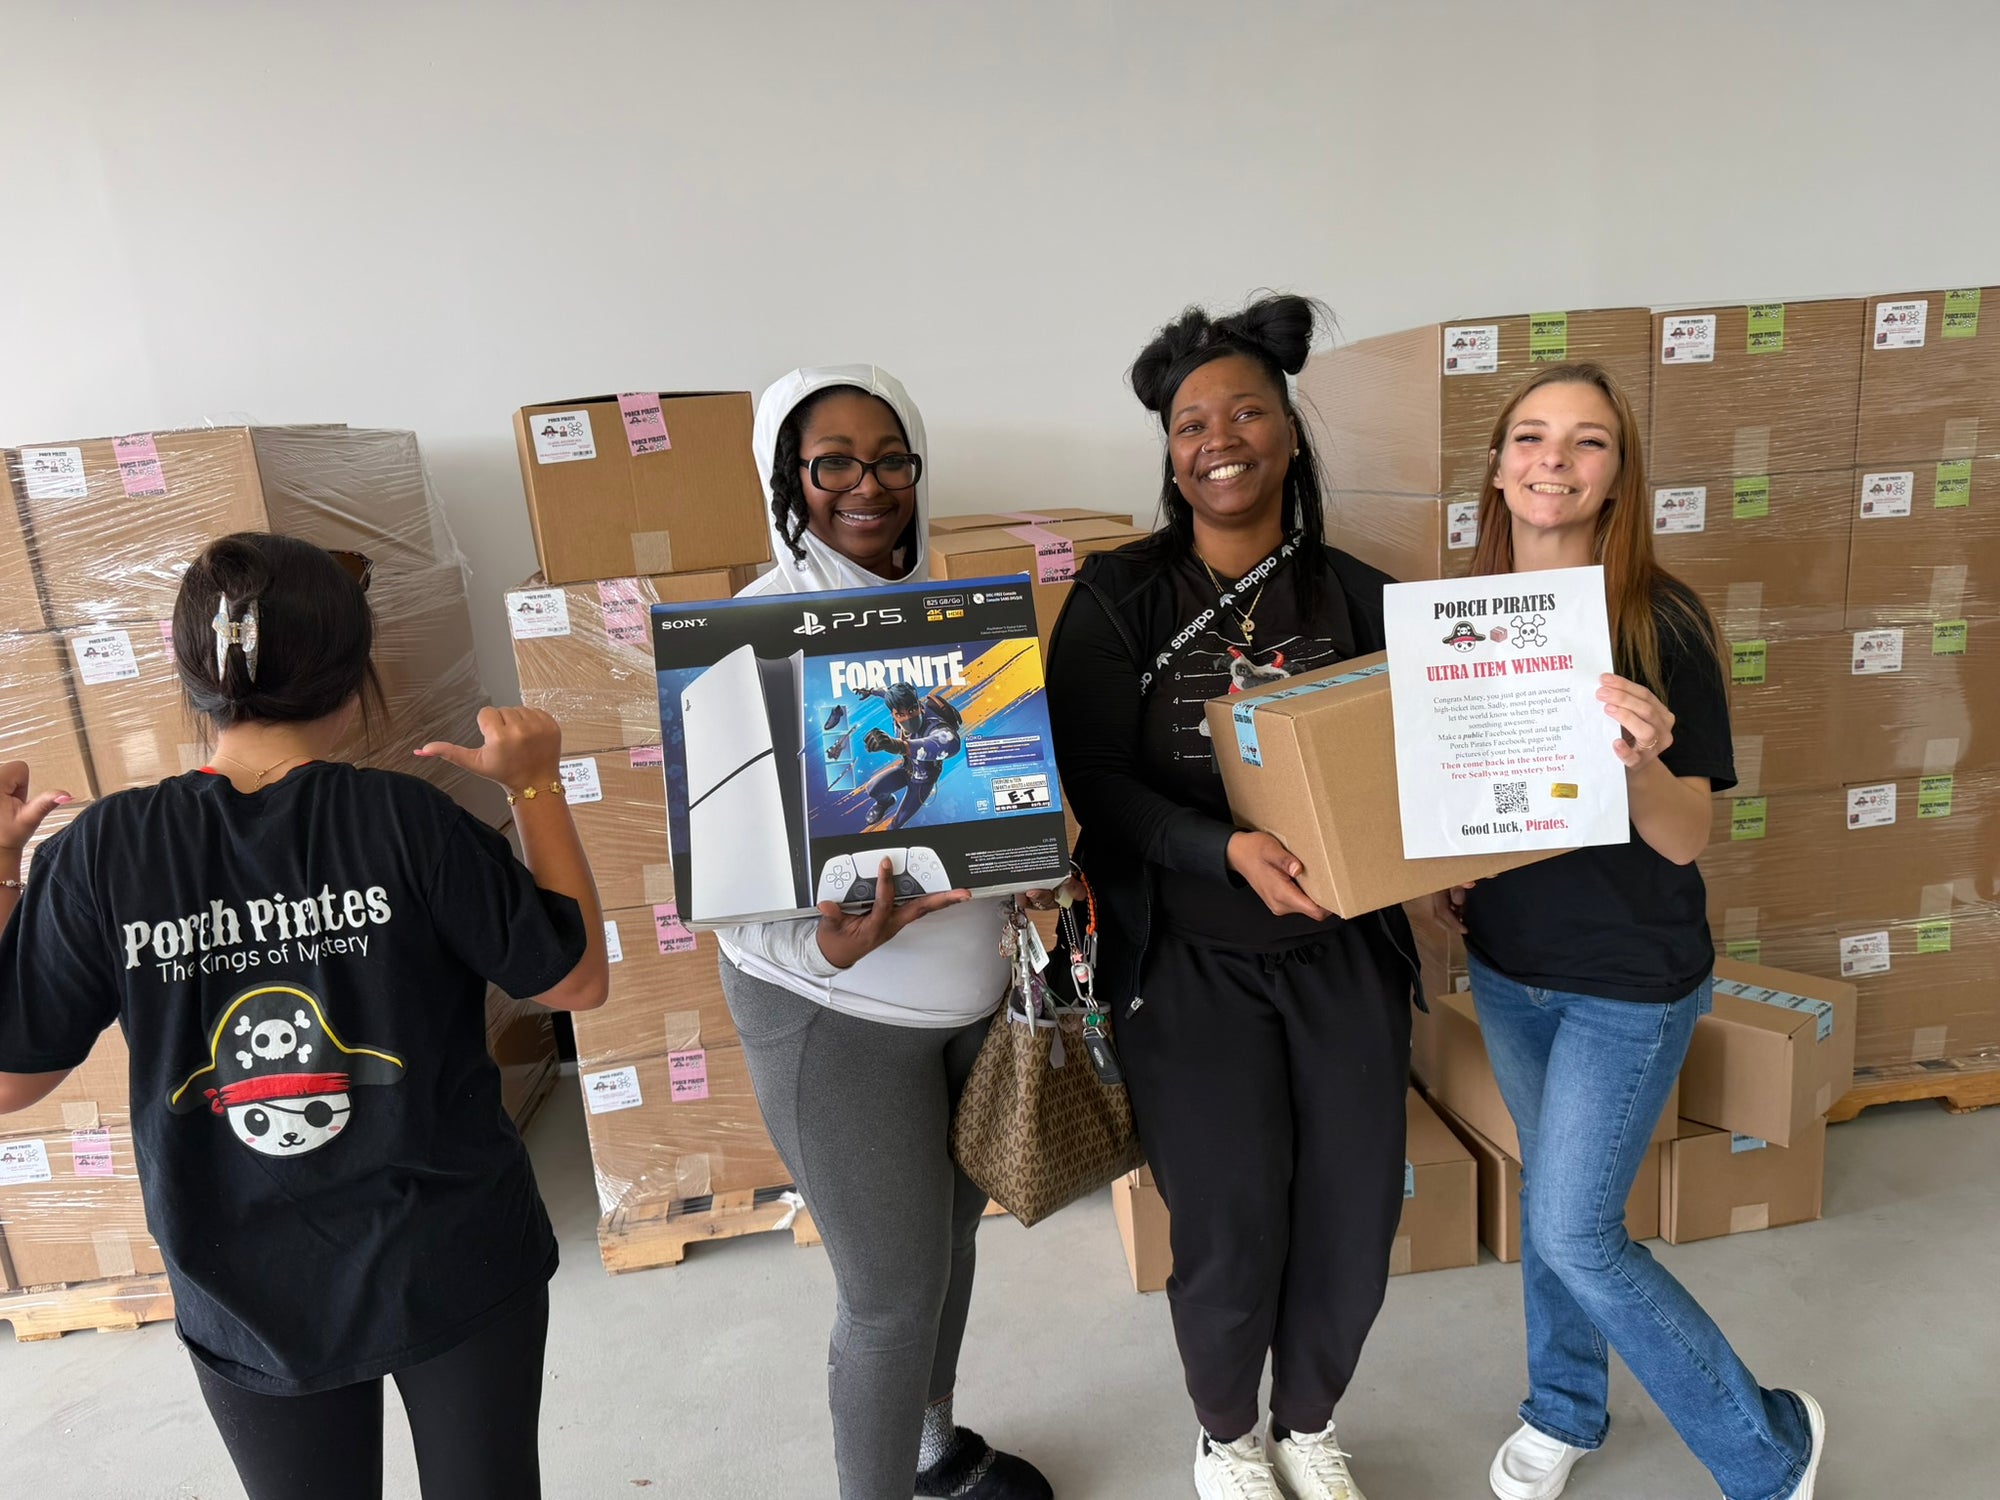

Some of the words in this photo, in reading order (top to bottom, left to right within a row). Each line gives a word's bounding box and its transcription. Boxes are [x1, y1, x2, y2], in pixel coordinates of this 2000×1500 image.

[1235, 556, 1277, 593] adidas
[1434, 599, 1487, 619] PORCH
[1492, 594, 1555, 615] PIRATES
[662, 618, 707, 630] SONY
[832, 608, 904, 629] PS5
[1170, 608, 1215, 650] adidas
[829, 650, 967, 699] FORTNITE
[1427, 664, 1469, 681] ULTRA
[1473, 661, 1507, 678] ITEM
[1512, 655, 1573, 674] WINNER!
[1434, 696, 1462, 704] Congrats
[1538, 687, 1571, 695] awesome
[1434, 705, 1468, 714] high-ticket
[1487, 701, 1509, 710] Sadly,
[1528, 697, 1552, 707] people
[1470, 712, 1488, 720] world
[1489, 711, 1508, 719] know
[1530, 707, 1545, 715] they
[1438, 733, 1456, 741] Make
[1463, 732, 1484, 740] public
[1485, 729, 1517, 737] Facebook
[1549, 725, 1560, 733] tag
[1469, 721, 1502, 730] something
[1504, 719, 1538, 727] awesome.
[1470, 740, 1492, 748] Pirates
[1494, 737, 1526, 746] Facebook
[1528, 737, 1544, 745] page
[1456, 751, 1481, 760] pictures
[1482, 749, 1489, 757] of
[1522, 745, 1535, 753] and
[1537, 744, 1557, 753] prize!
[1440, 762, 1461, 770] Then
[1518, 756, 1530, 764] the
[1452, 772, 1467, 780] free
[1469, 769, 1509, 778] Scallywag
[1512, 767, 1544, 775] mystery
[1546, 764, 1565, 772] box!
[1462, 823, 1490, 836] Good
[1493, 821, 1523, 834] Luck,
[1526, 818, 1569, 831] Pirates.
[123, 899, 243, 970] Porch
[246, 884, 392, 942] Pirates
[156, 960, 196, 982] The
[268, 946, 289, 965] of
